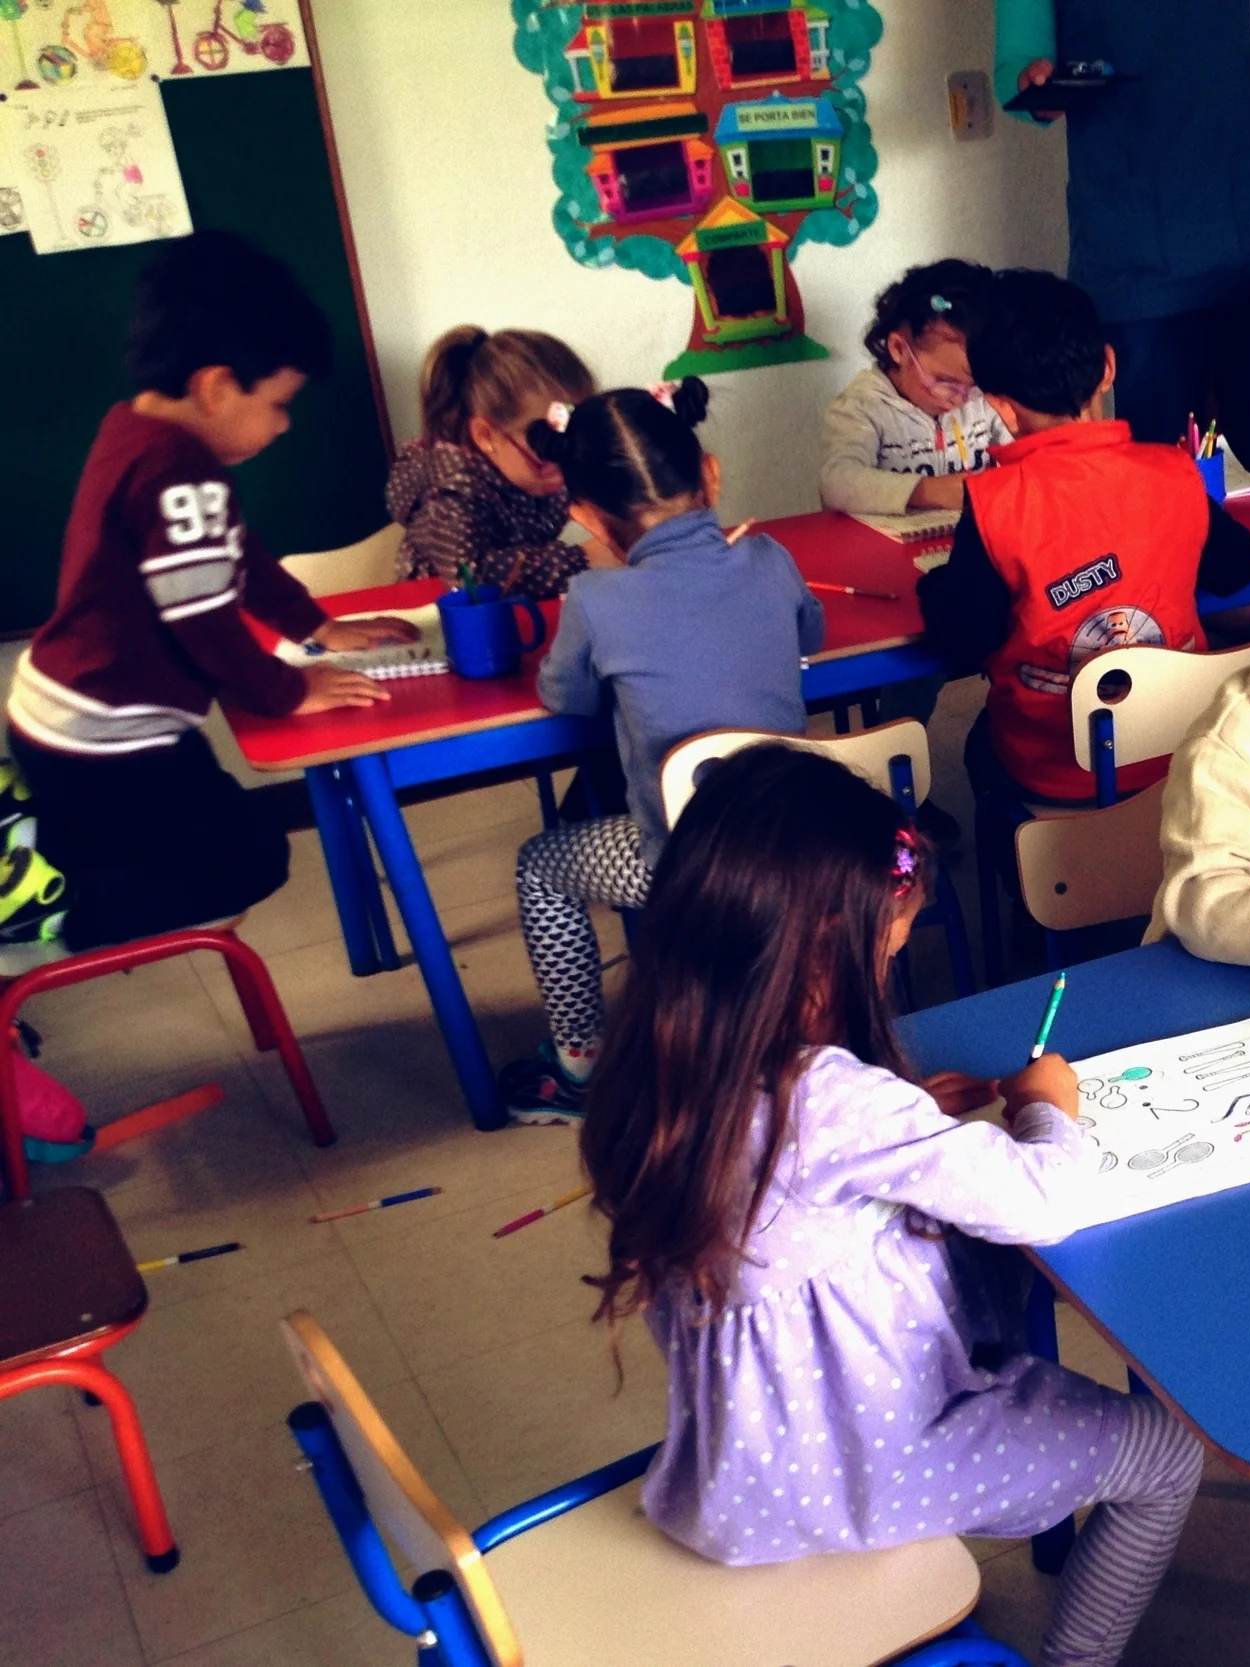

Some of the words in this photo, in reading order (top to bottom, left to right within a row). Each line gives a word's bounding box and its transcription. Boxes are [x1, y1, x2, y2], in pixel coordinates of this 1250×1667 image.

[754, 109, 788, 122] PORTA
[791, 107, 815, 120] BIEN
[1050, 557, 1118, 607] DUSTY
